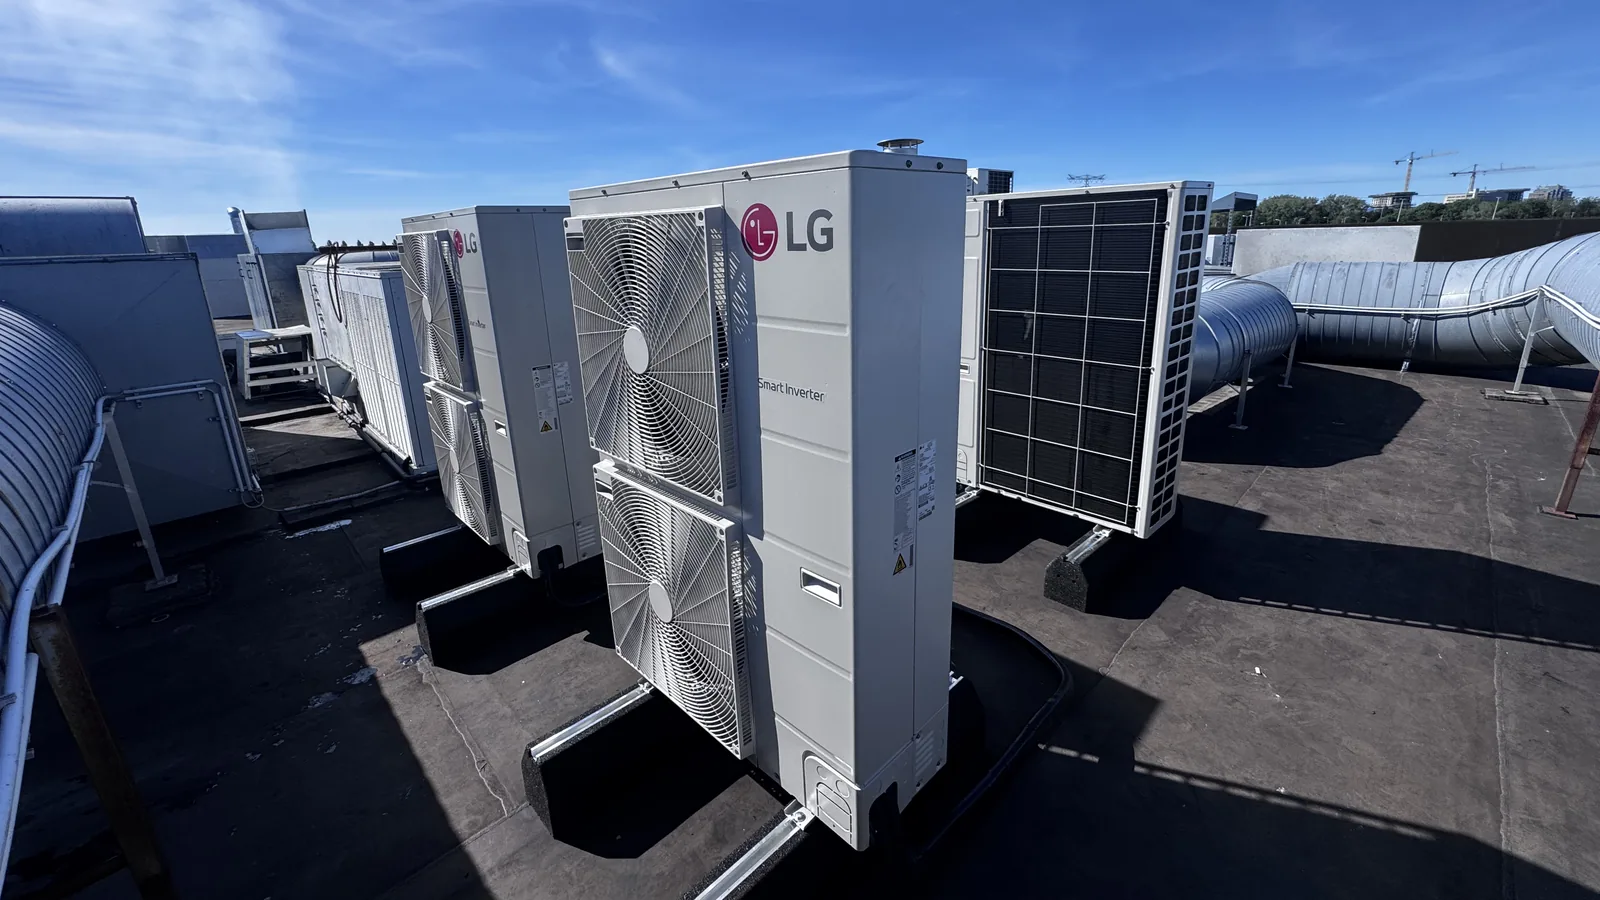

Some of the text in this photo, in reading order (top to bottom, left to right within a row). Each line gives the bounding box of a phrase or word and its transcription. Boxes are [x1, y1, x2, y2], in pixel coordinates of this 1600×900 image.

[786, 208, 834, 252] LG
[464, 232, 478, 254] LG
[757, 377, 825, 402] Smart Inverter
